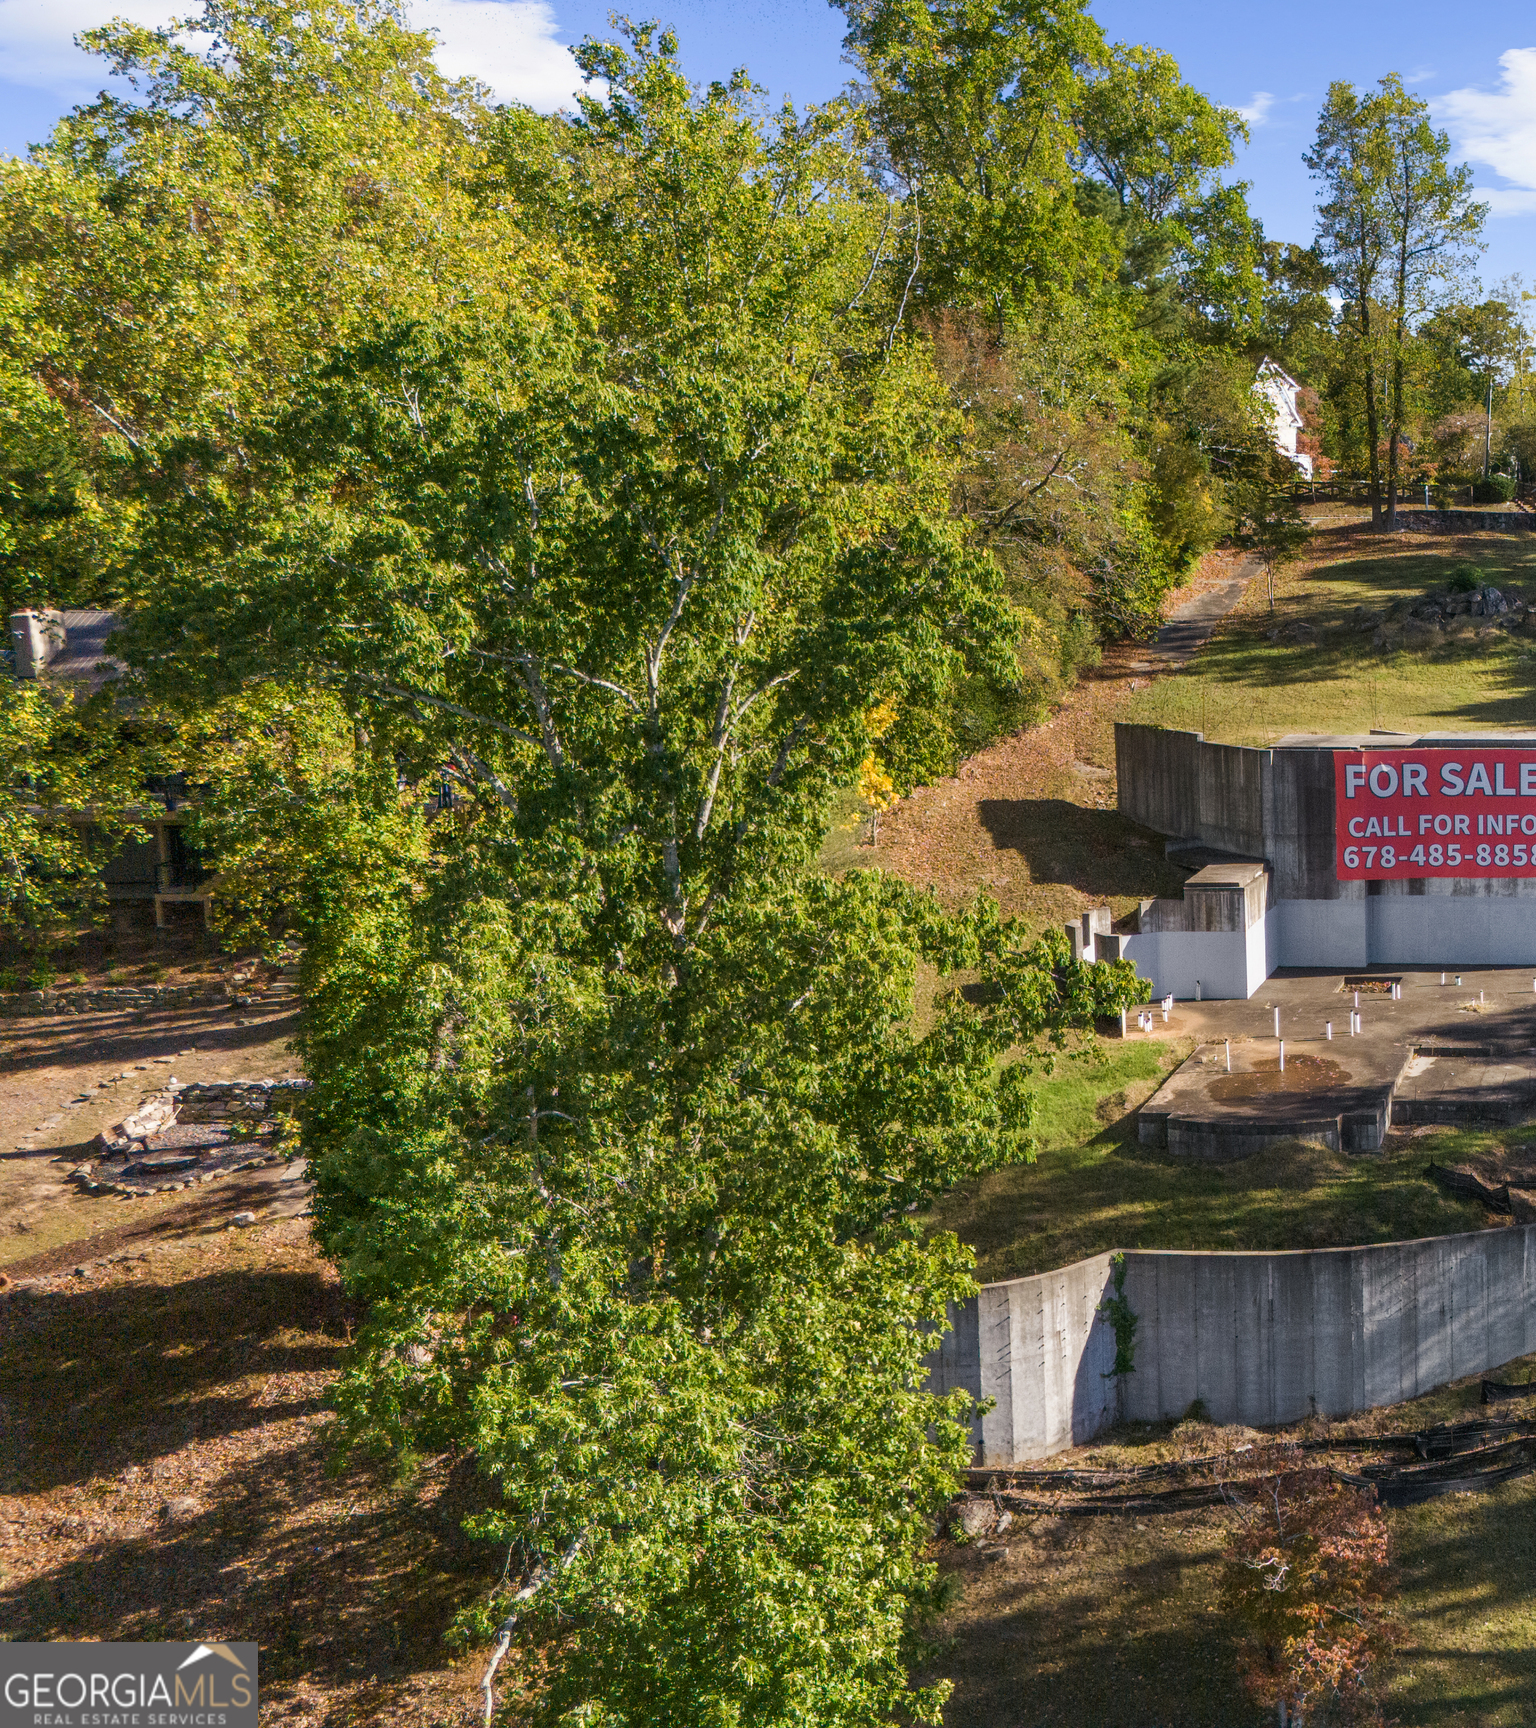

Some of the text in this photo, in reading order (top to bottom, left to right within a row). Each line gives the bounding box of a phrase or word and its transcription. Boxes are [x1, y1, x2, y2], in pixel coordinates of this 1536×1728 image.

[1345, 763, 1430, 798] FOR
[1348, 816, 1412, 838] CALL
[1418, 814, 1471, 836] FOR
